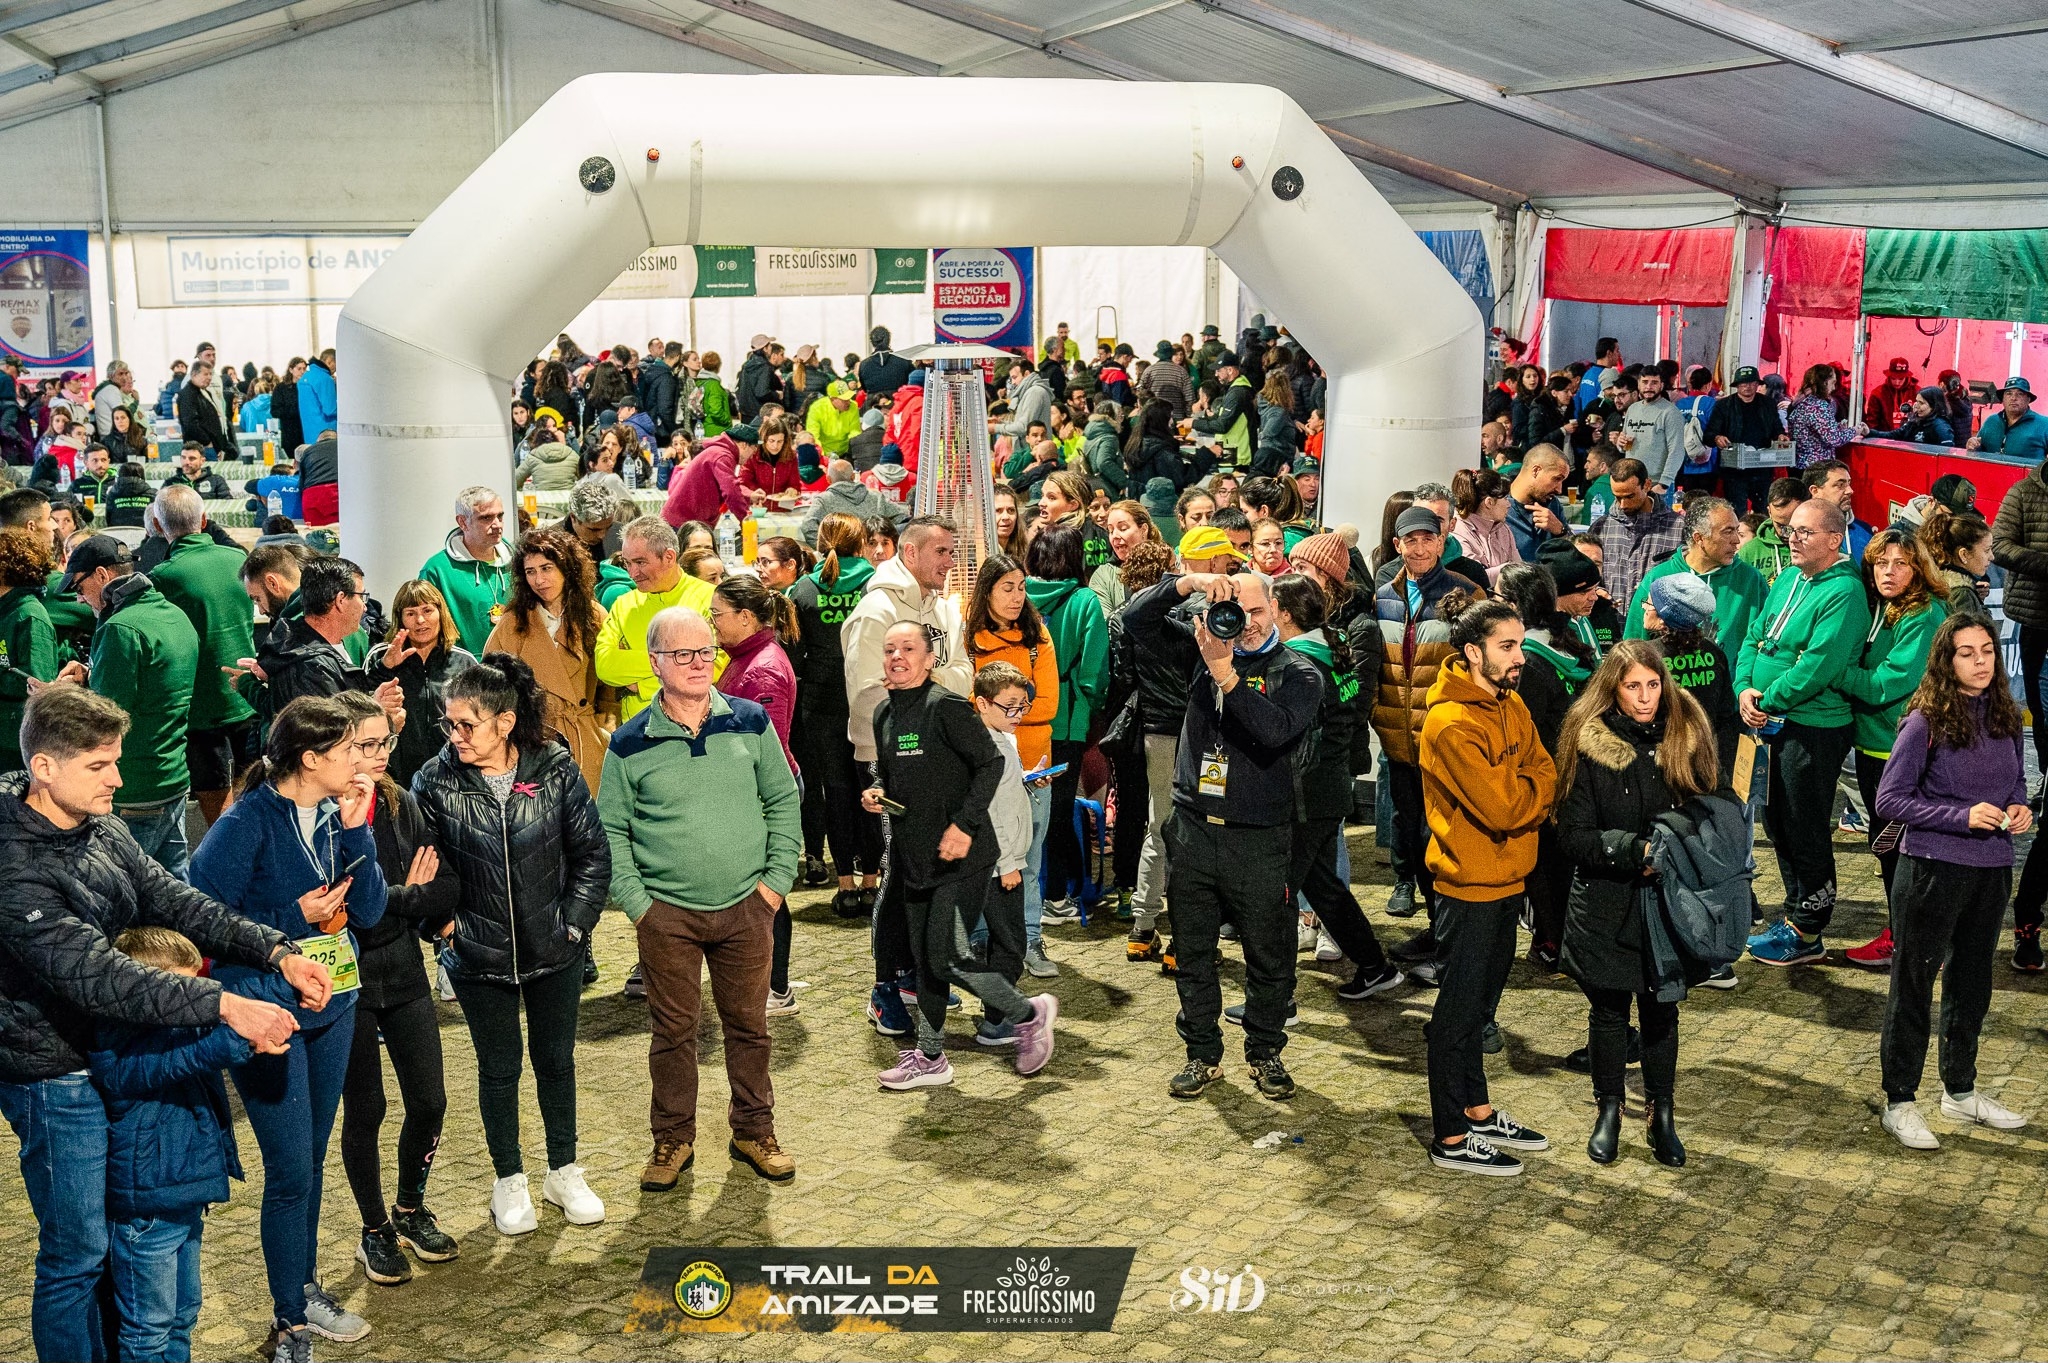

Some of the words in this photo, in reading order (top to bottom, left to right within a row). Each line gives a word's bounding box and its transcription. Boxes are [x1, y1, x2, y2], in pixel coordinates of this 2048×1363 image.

[181, 249, 301, 274] Município
[308, 249, 337, 269] de
[939, 268, 1004, 278] SUCESSO!
[939, 286, 987, 295] ESTAMOS
[989, 286, 997, 294] A
[1, 300, 40, 308] RE/MAX
[939, 294, 1006, 305] RECRUTAR!
[816, 591, 862, 608] BOTÃ
[821, 610, 851, 624] CA
[1662, 650, 1715, 672] BOTÃO
[1340, 679, 1359, 703] CAMP
[897, 732, 919, 742] BOTÃO
[898, 742, 919, 750] CAMP
